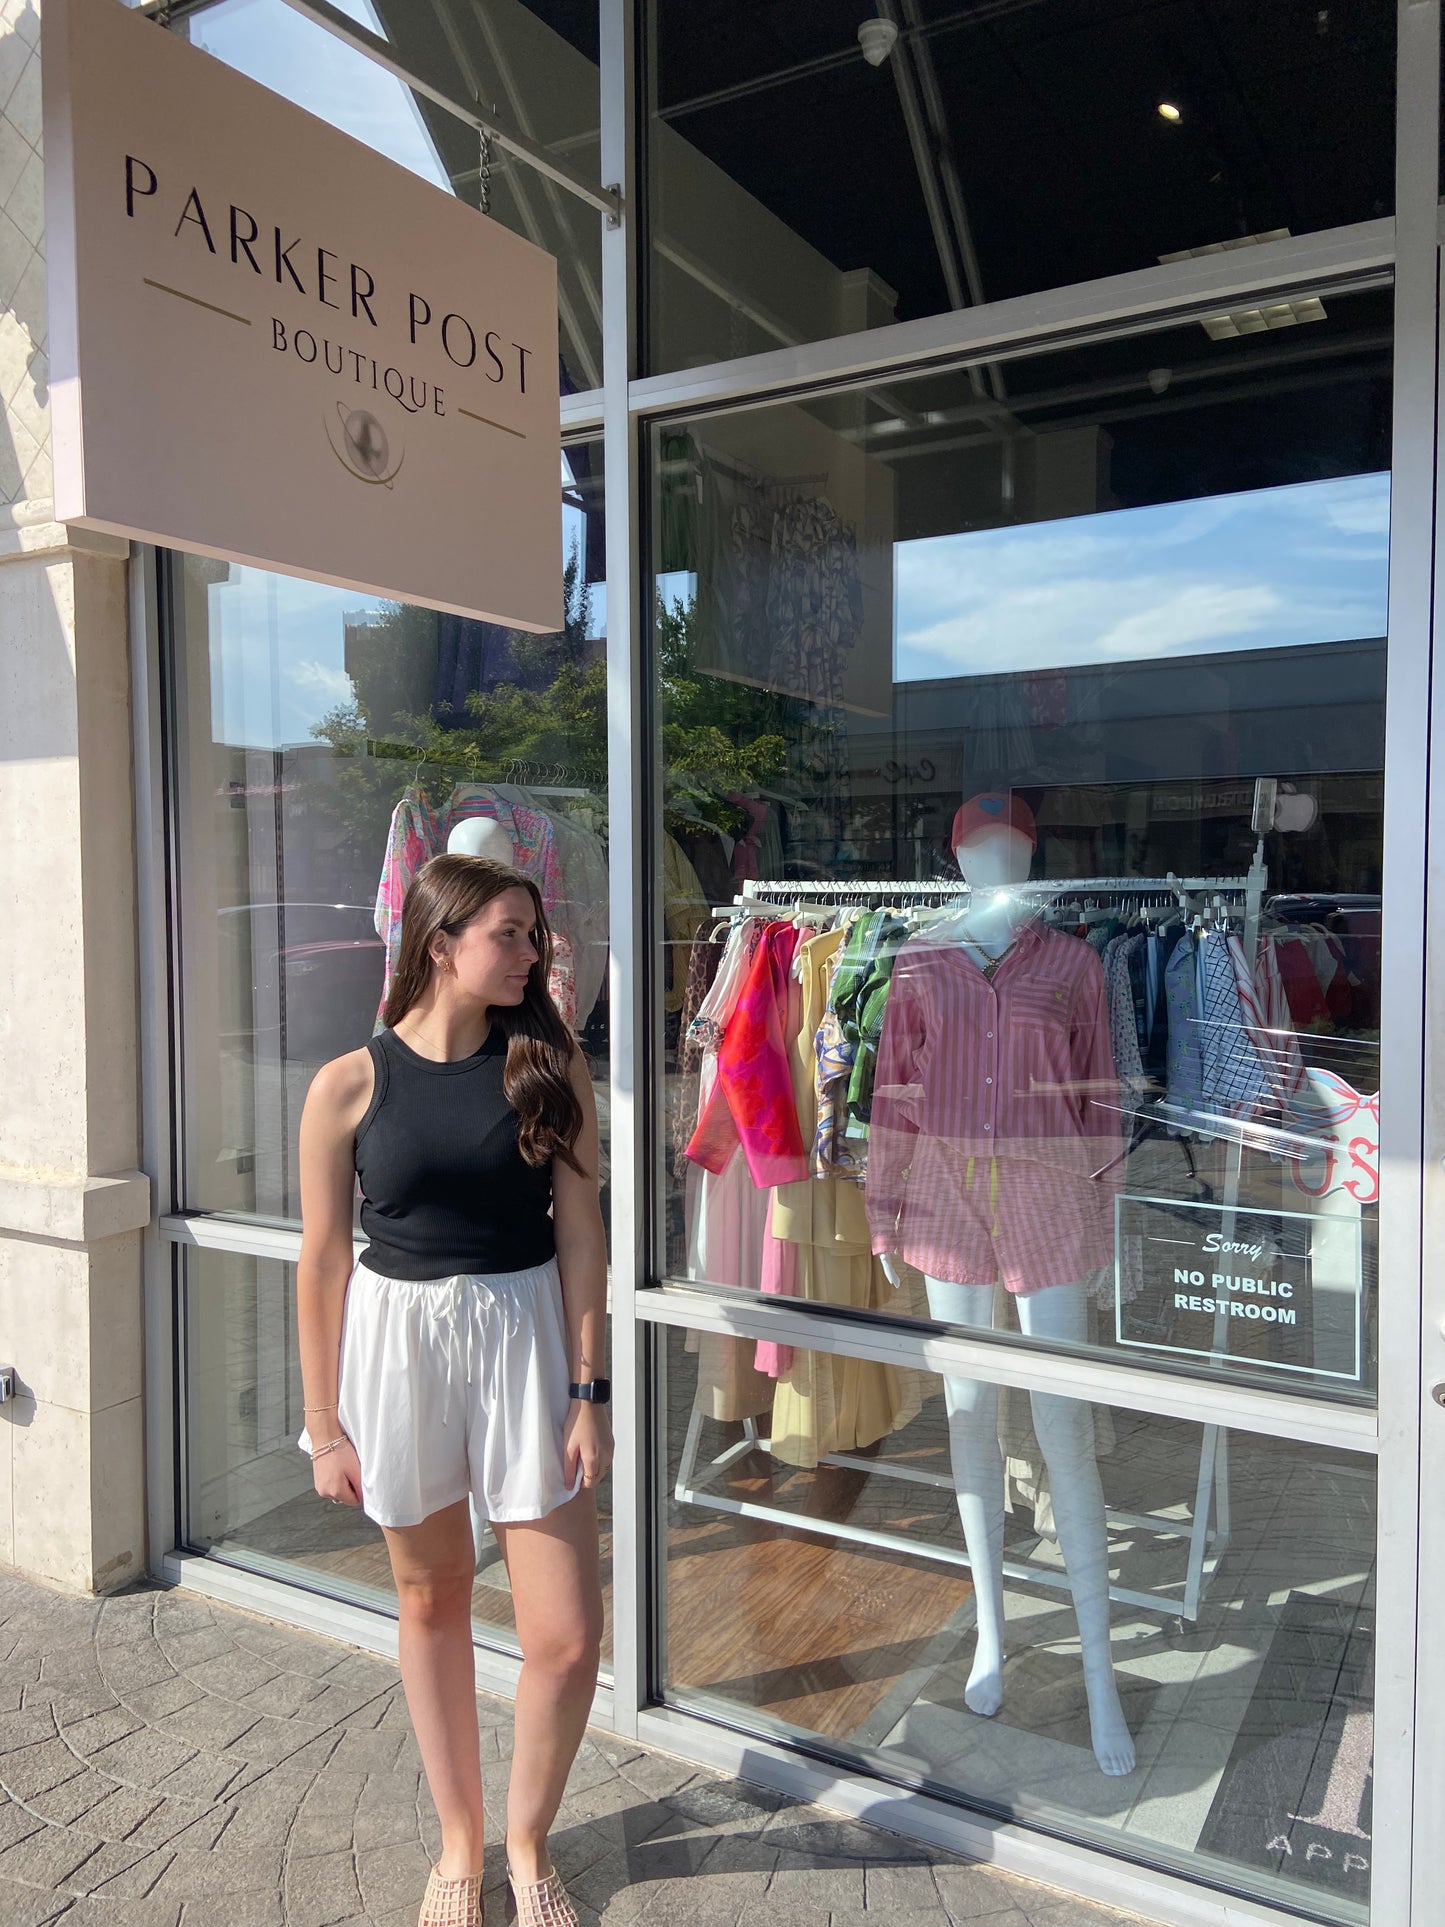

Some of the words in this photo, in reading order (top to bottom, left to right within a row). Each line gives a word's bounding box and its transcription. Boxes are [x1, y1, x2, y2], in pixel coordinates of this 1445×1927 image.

[125, 154, 379, 328] PARKER
[408, 292, 533, 395] POST
[270, 316, 447, 418] BOUTIQUE
[1201, 1233, 1264, 1262] Sorry
[1174, 1268, 1205, 1286] NO
[1211, 1273, 1294, 1298] PUBLIC
[1174, 1293, 1296, 1325] RESTROOM
